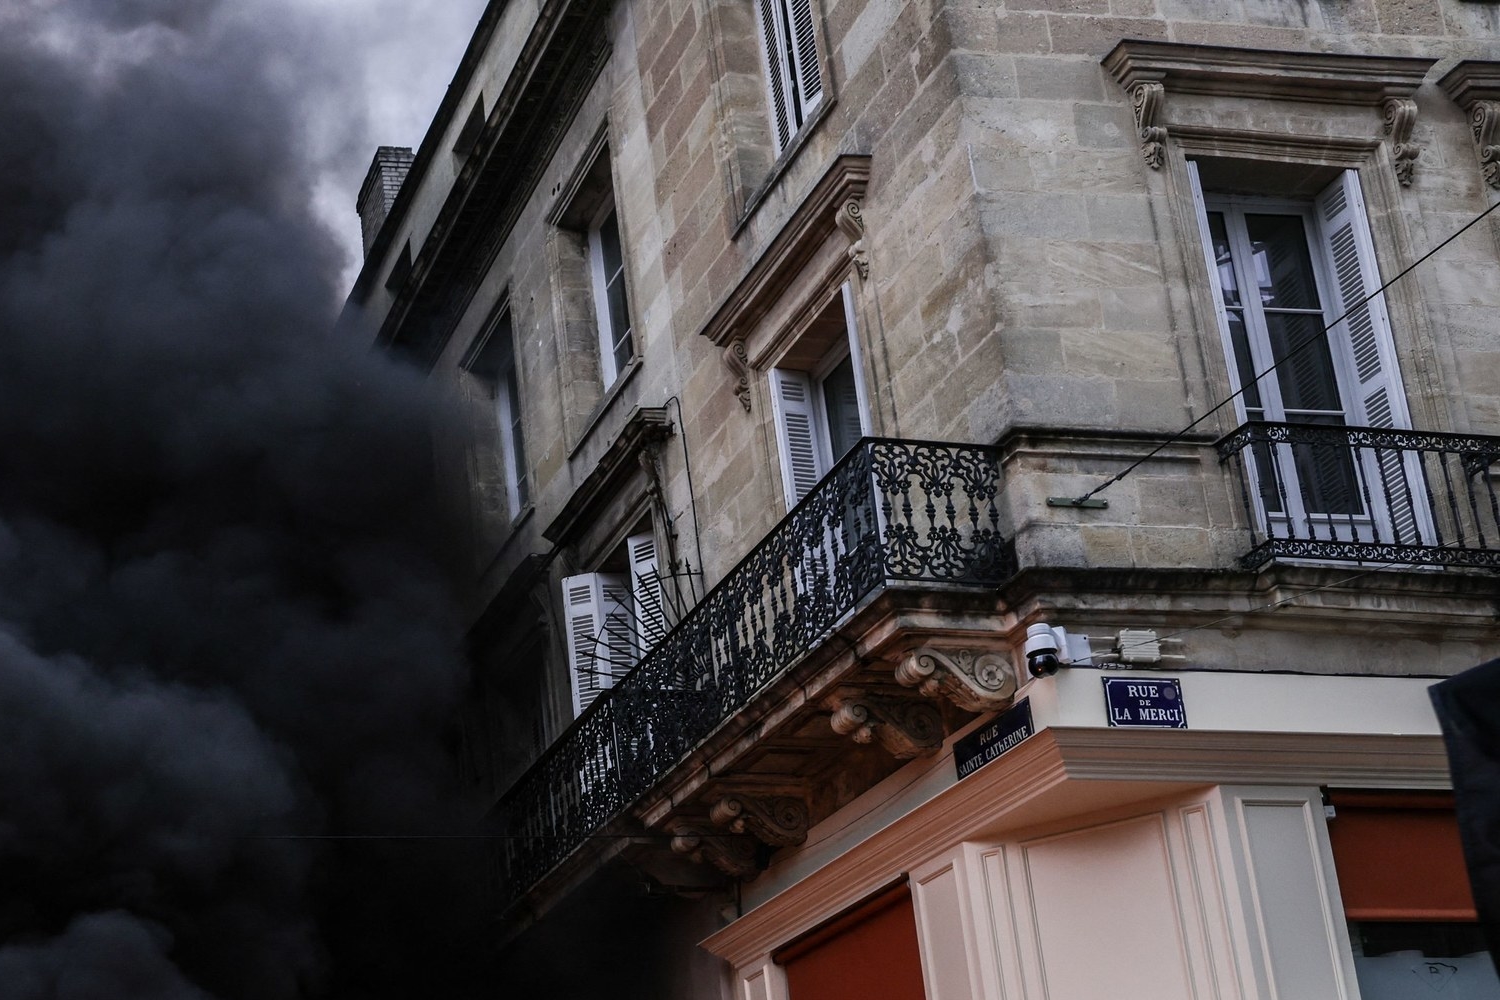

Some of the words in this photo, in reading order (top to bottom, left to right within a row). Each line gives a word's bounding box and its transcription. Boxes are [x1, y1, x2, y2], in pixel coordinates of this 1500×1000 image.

[1127, 685, 1159, 697] RUE
[1114, 707, 1132, 720] LA
[1139, 708, 1180, 721] MERCI
[980, 724, 999, 746] RUE
[958, 753, 984, 777] SAINTE
